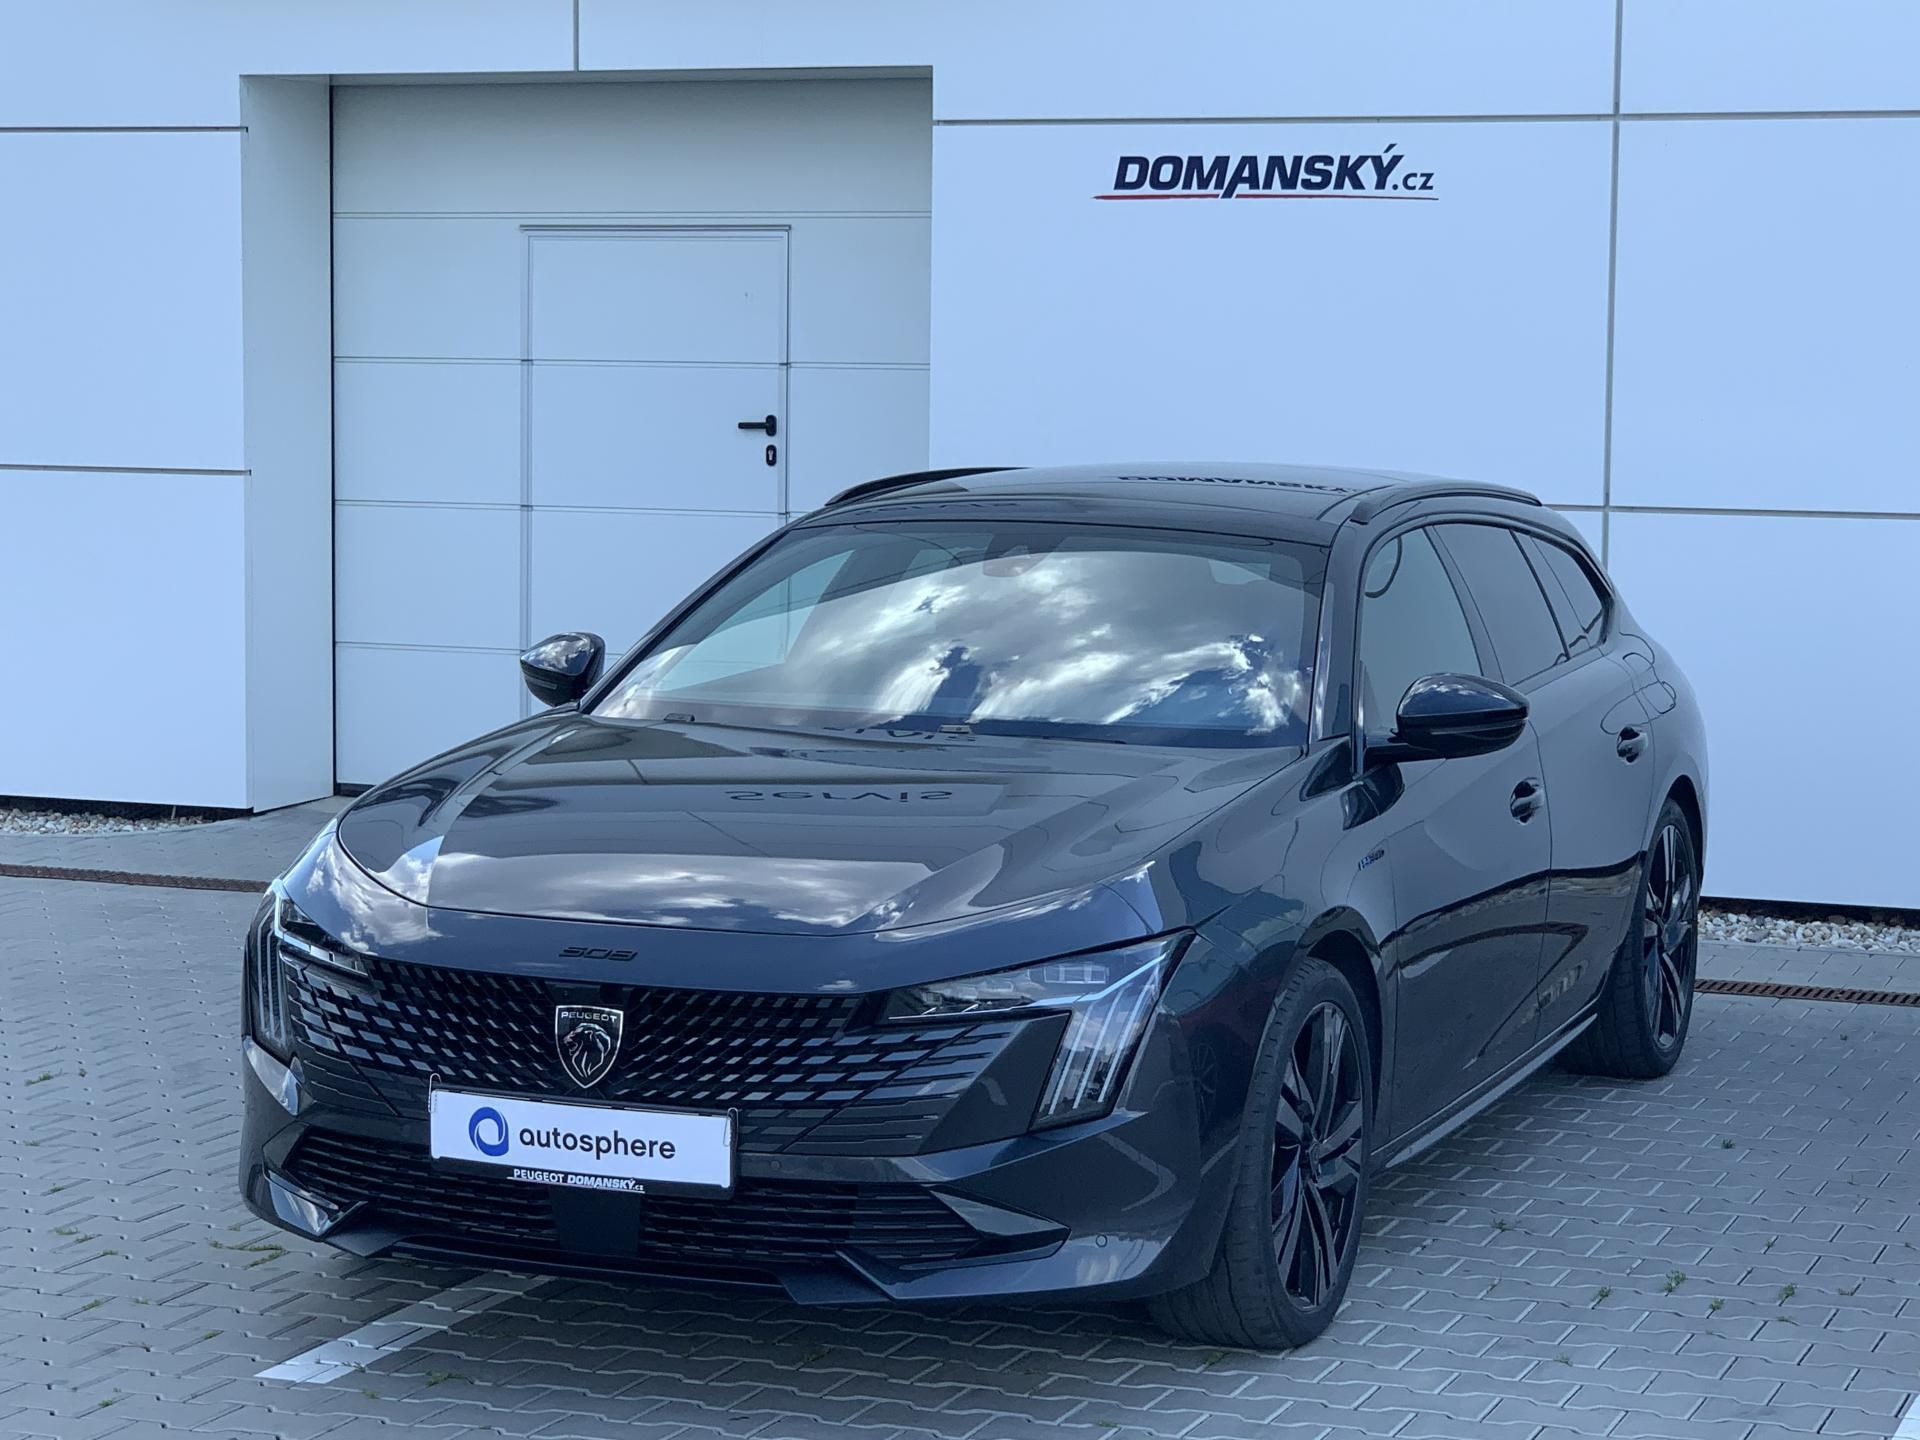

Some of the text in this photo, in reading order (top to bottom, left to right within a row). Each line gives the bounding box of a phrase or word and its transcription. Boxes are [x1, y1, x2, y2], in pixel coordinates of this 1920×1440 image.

[1113, 143, 1435, 198] DOMANSKÝ.cz
[558, 946, 638, 962] 508
[561, 1011, 618, 1023] PEUGEOT
[519, 1127, 676, 1160] autosphere
[513, 1168, 565, 1183] PEUGEOT
